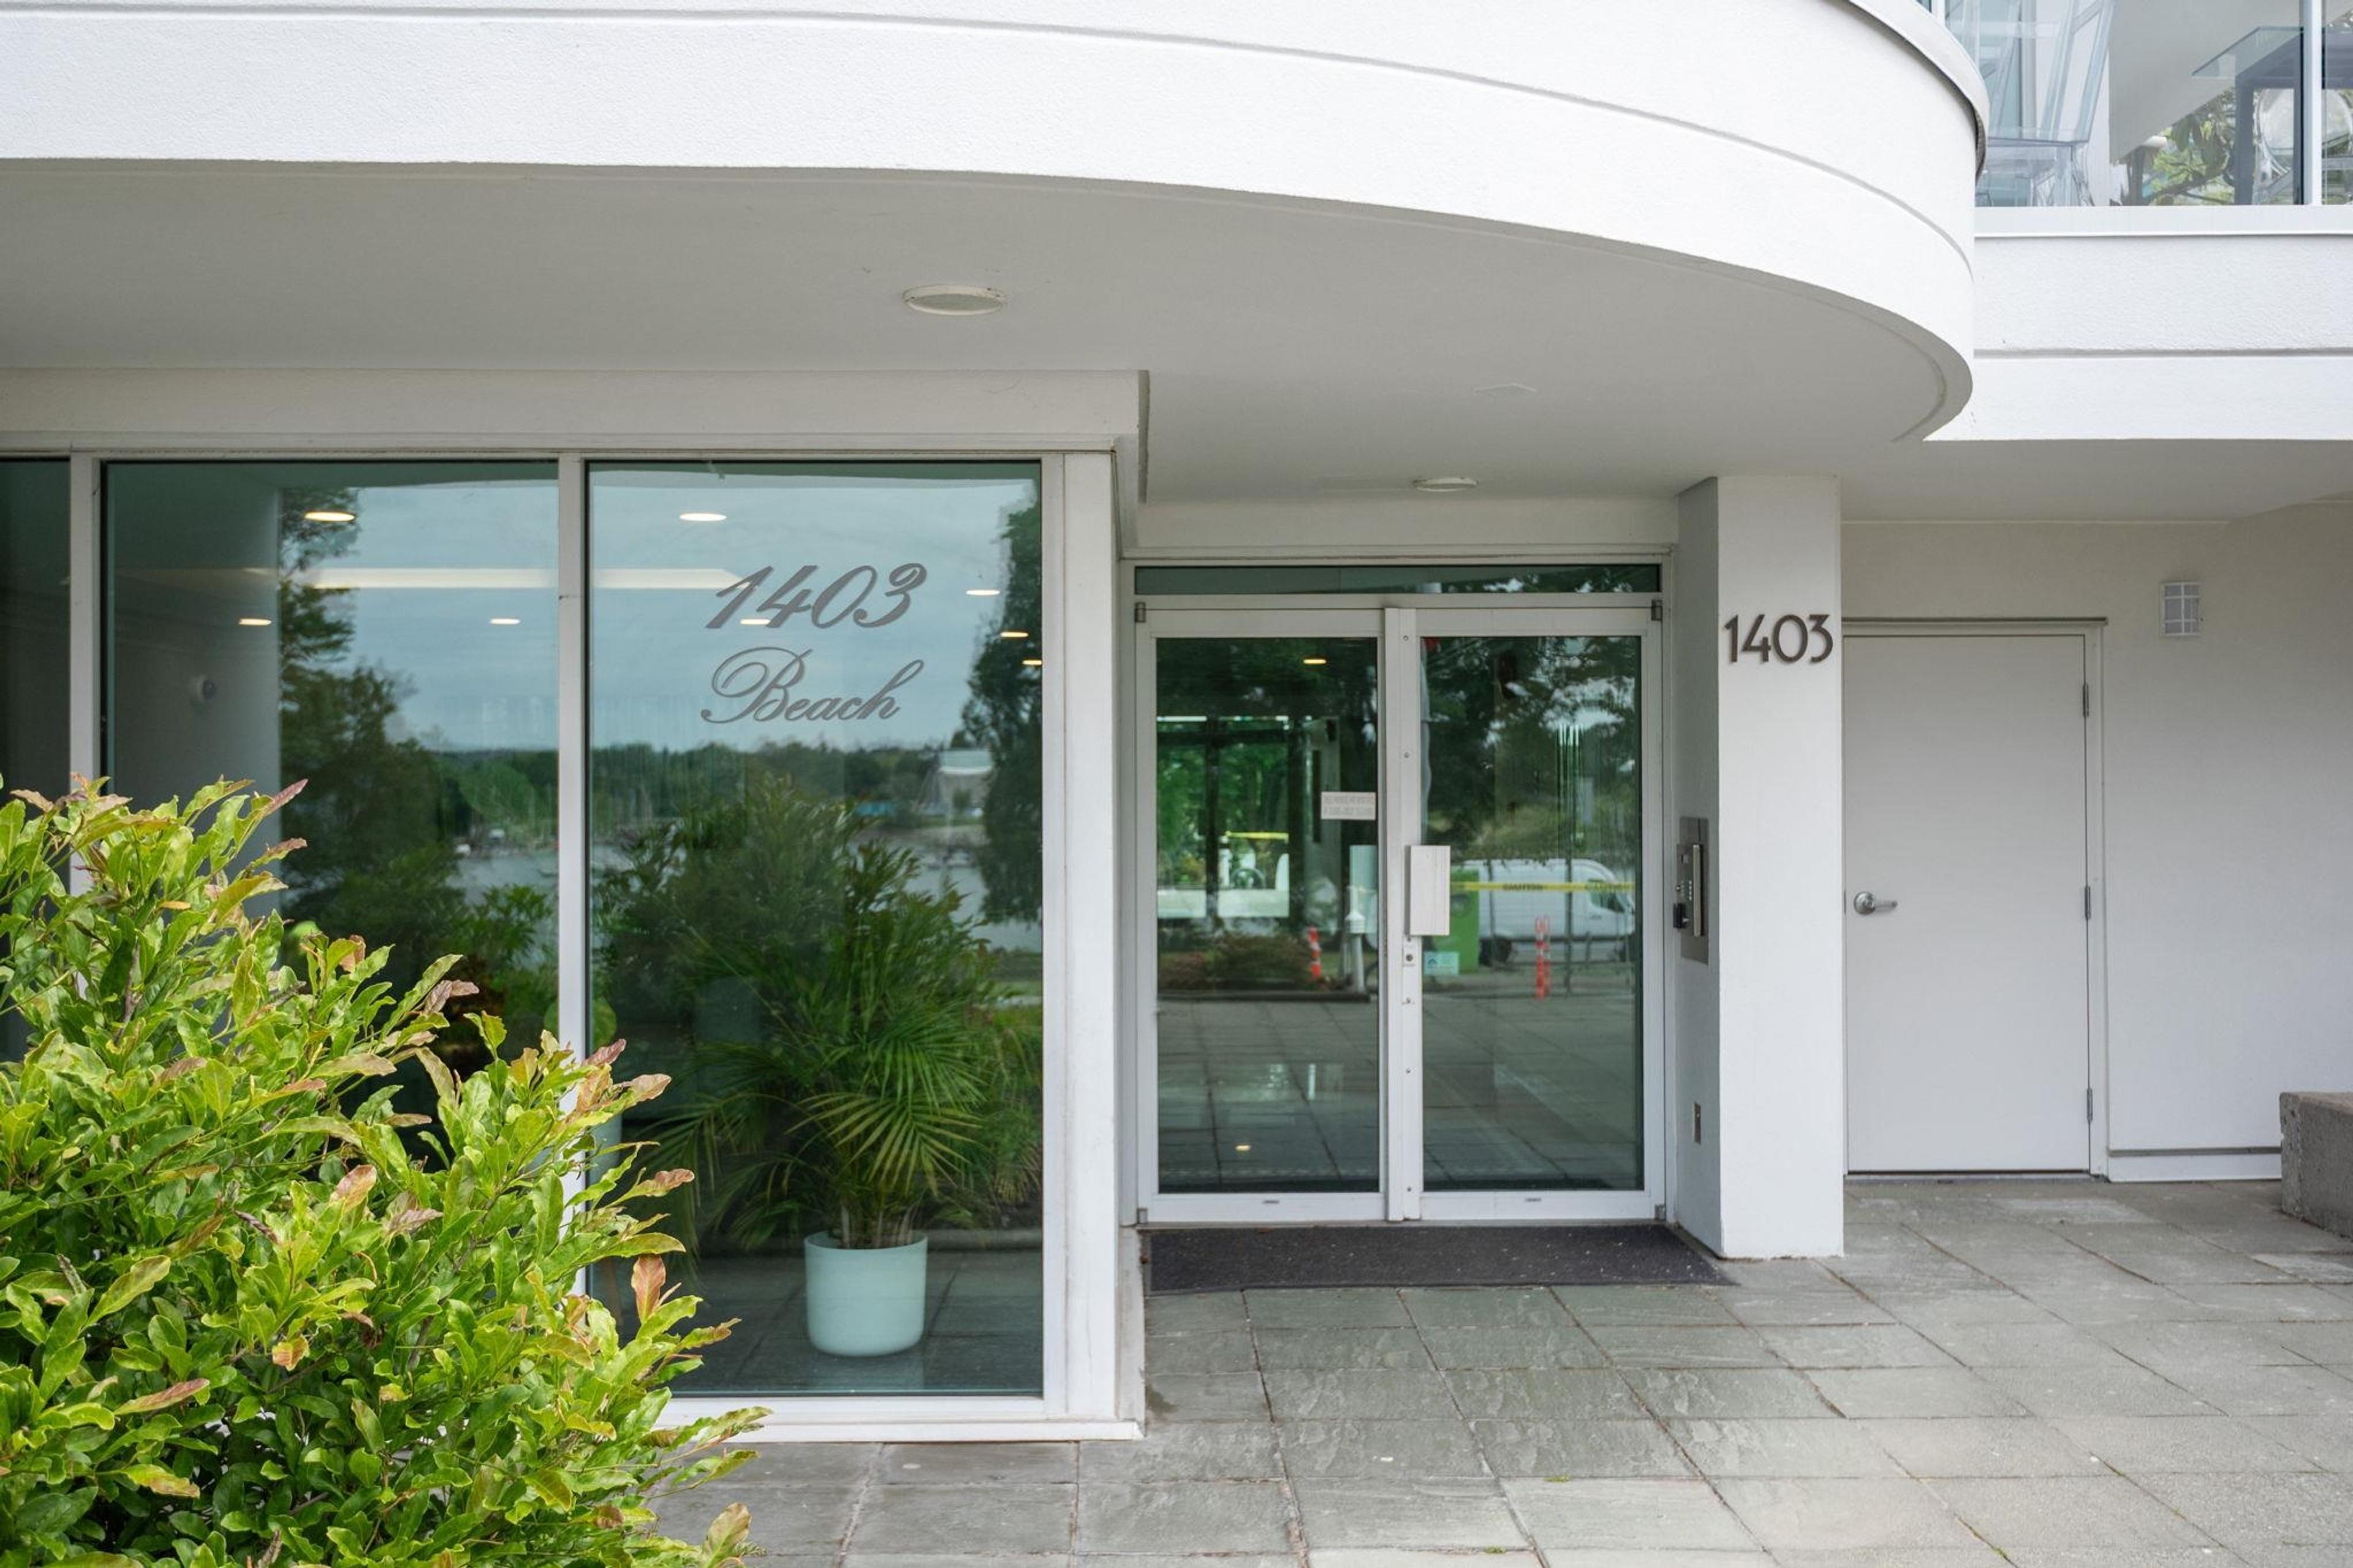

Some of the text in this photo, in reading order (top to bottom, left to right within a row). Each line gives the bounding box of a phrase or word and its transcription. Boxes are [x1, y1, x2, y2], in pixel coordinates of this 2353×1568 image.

[705, 562, 927, 629] 1403
[1724, 614, 1833, 662] 1403
[700, 646, 924, 724] Beach
